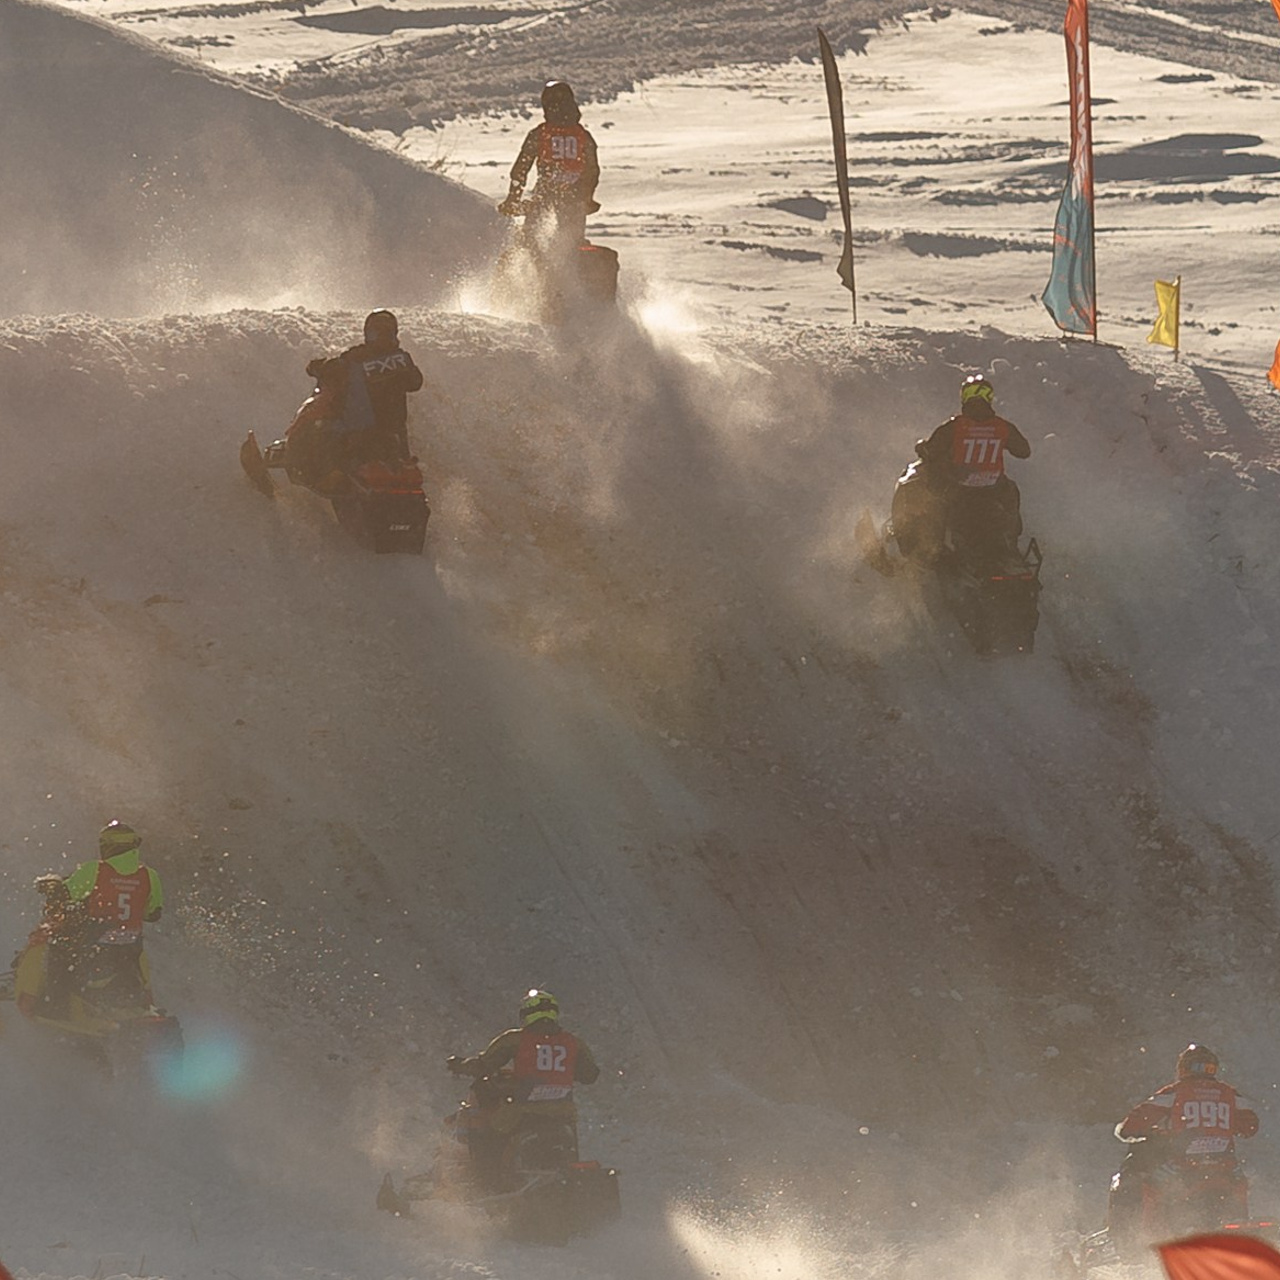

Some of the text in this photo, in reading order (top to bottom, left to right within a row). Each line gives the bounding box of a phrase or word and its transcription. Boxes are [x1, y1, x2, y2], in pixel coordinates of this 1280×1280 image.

[363, 353, 407, 377] FXR
[963, 439, 1001, 464] 777
[118, 893, 131, 921] 5
[535, 1043, 568, 1072] 82
[1183, 1101, 1231, 1130] 999
